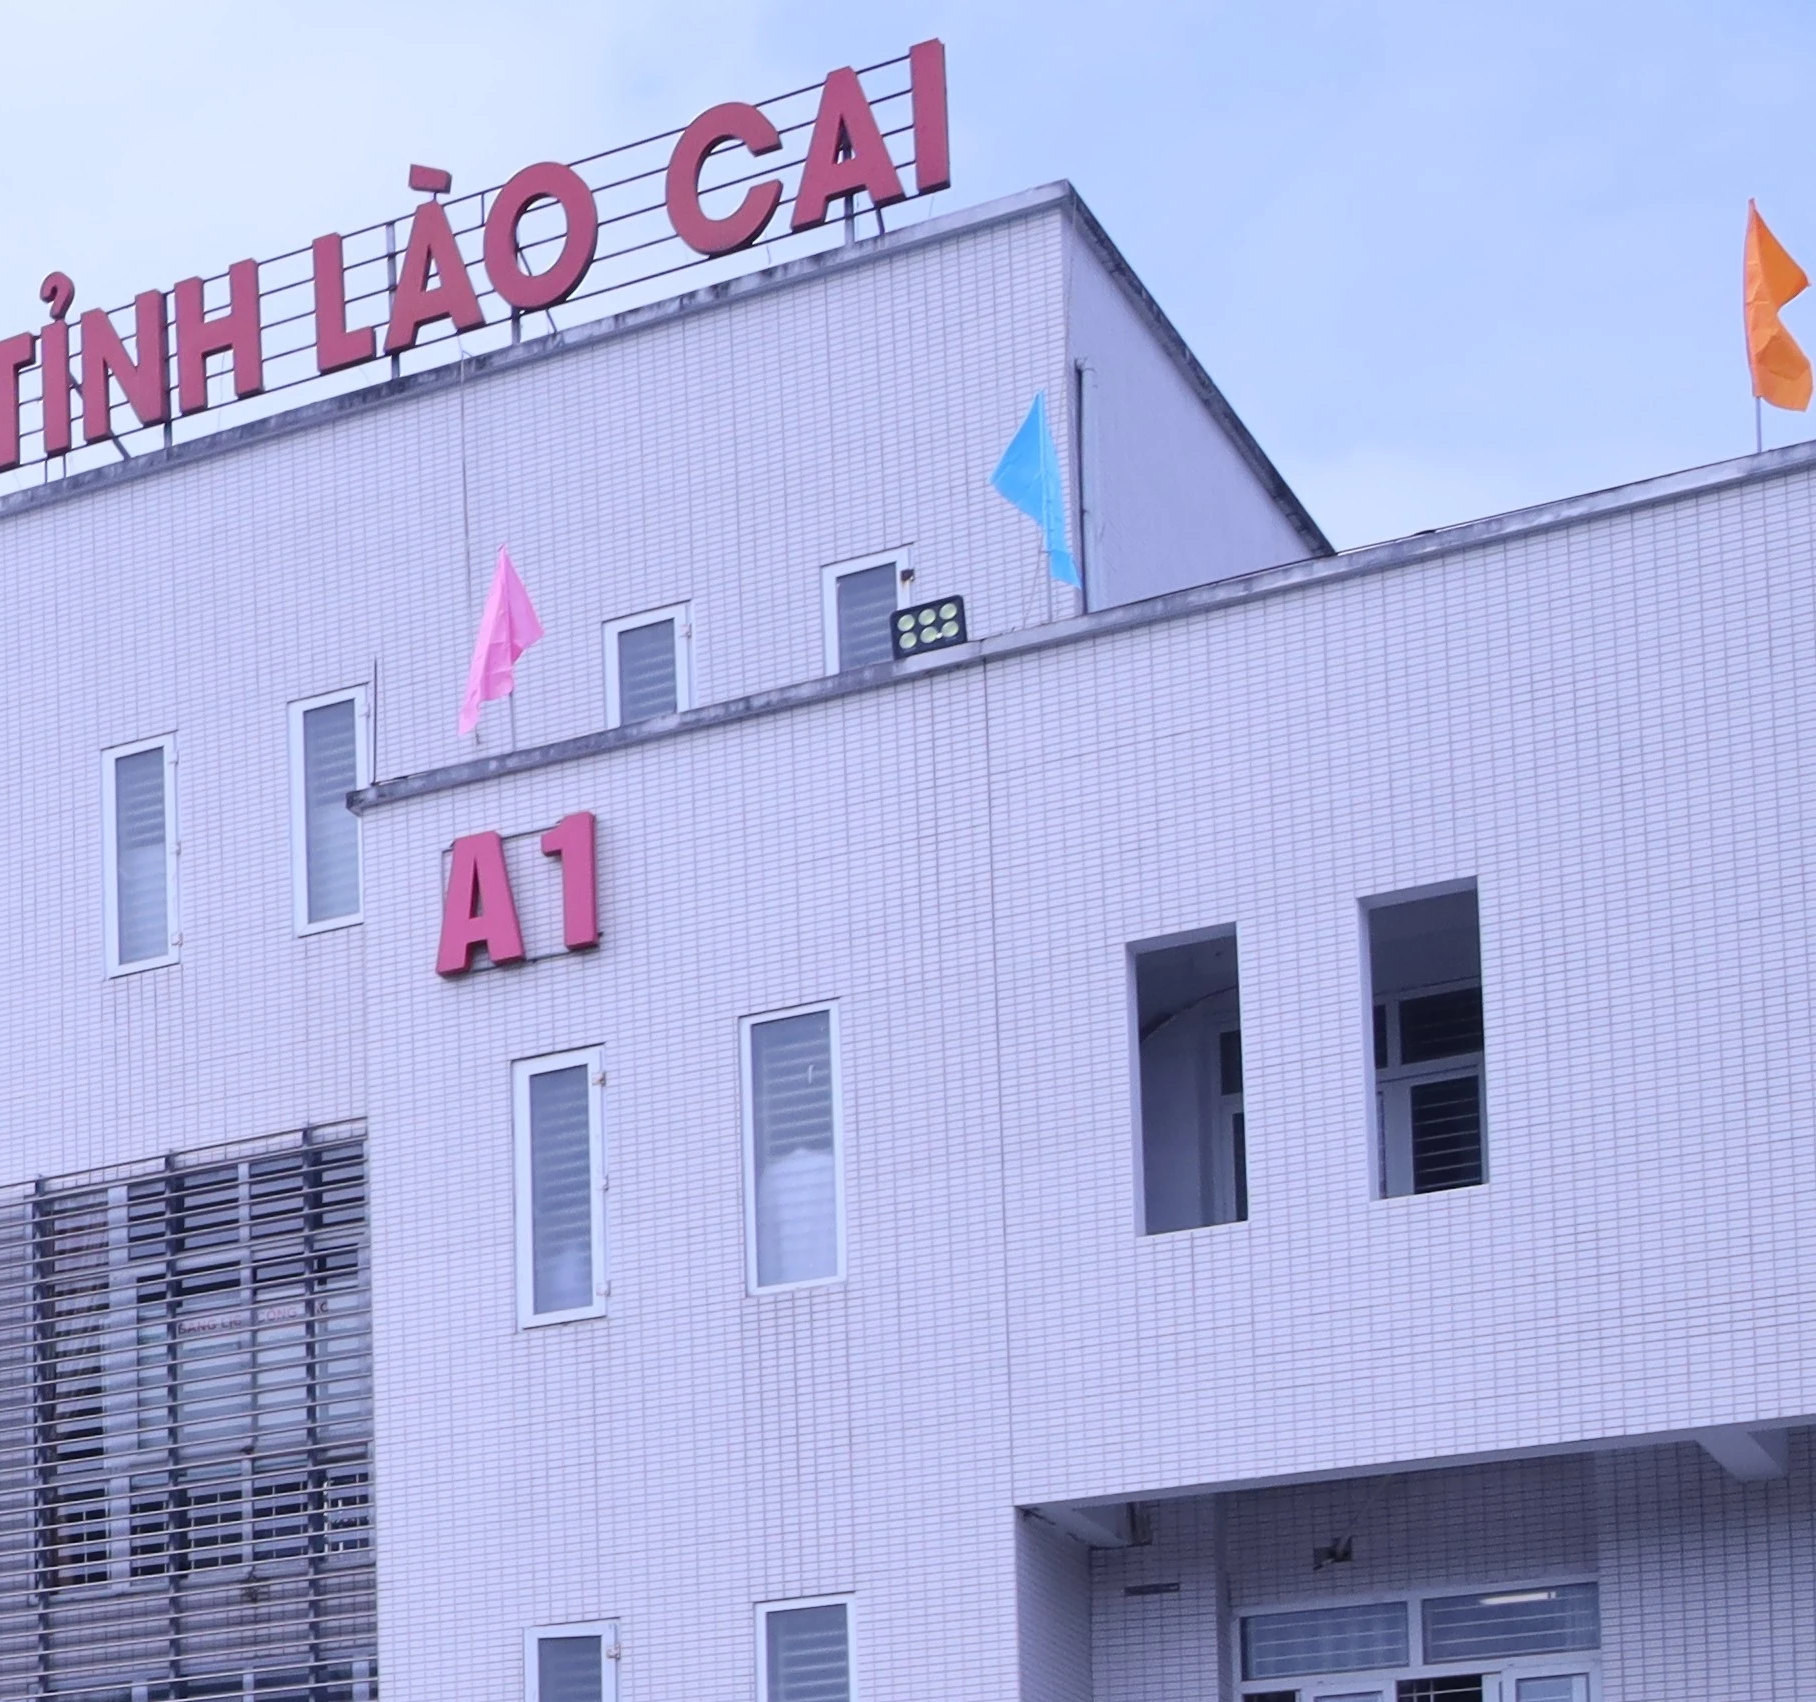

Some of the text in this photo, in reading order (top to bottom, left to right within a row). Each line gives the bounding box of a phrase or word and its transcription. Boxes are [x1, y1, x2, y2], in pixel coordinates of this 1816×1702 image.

[311, 163, 599, 376] LÀO
[665, 37, 952, 257] CAI
[436, 811, 601, 978] A1
